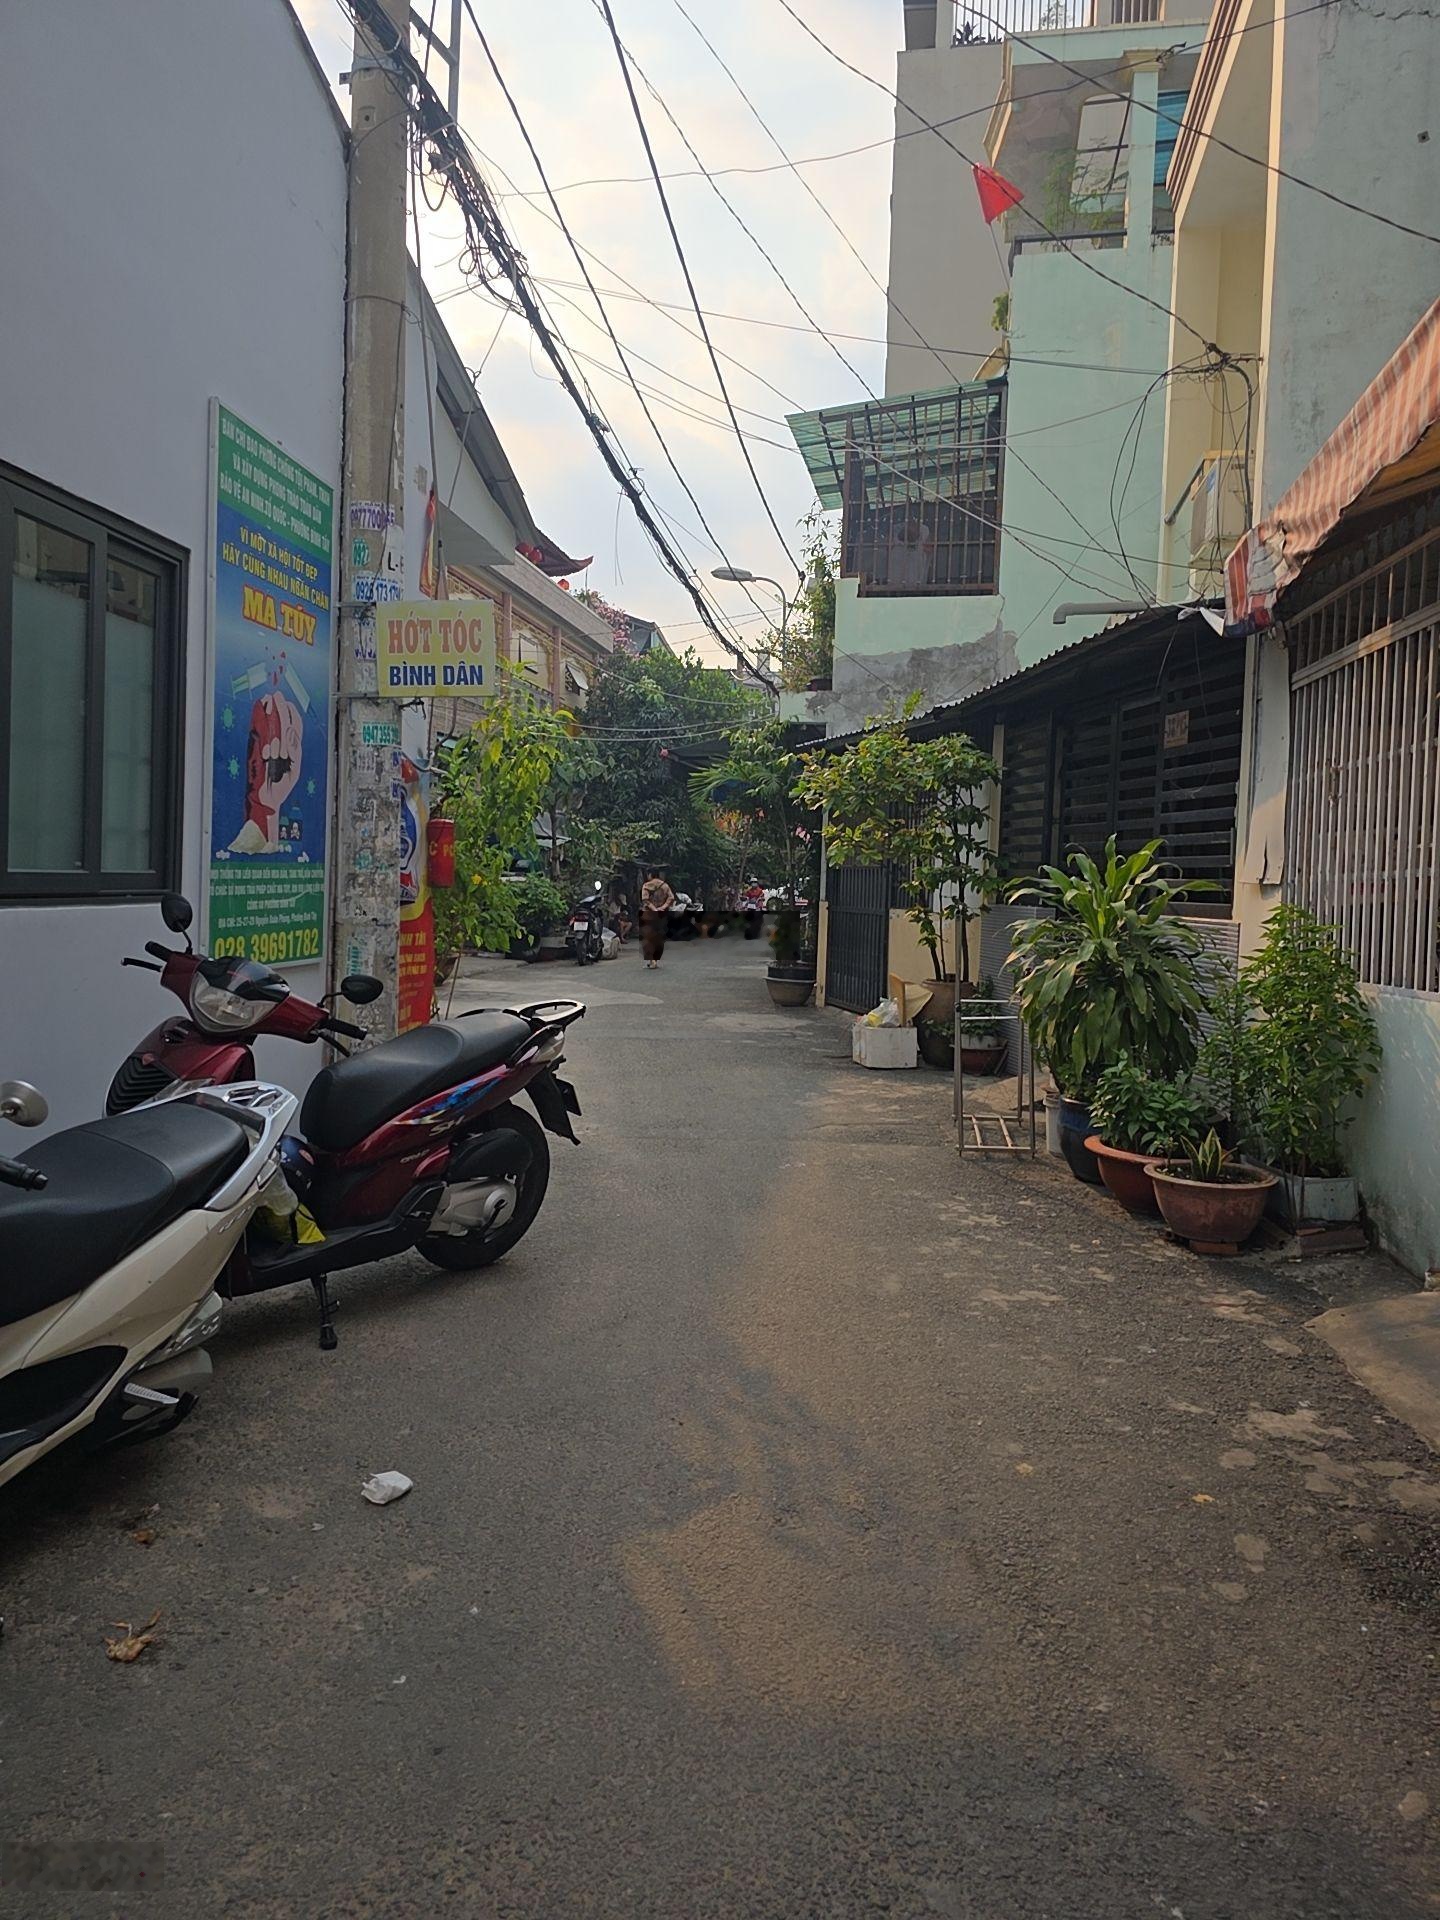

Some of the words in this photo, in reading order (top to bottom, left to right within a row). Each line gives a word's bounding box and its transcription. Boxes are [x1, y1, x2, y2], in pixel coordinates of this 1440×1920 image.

[240, 525, 248, 544] VÌ
[222, 541, 240, 566] HÃY
[242, 552, 266, 580] CÙNG
[267, 566, 288, 592] NHAU
[243, 584, 278, 631] MA
[280, 603, 317, 646] TÚY
[388, 610, 432, 654] HỚT
[438, 610, 482, 654] TÓC
[389, 661, 436, 686] BÌNH
[442, 660, 484, 686] DÂN
[214, 936, 246, 959] 028
[250, 928, 319, 962] 39691782
